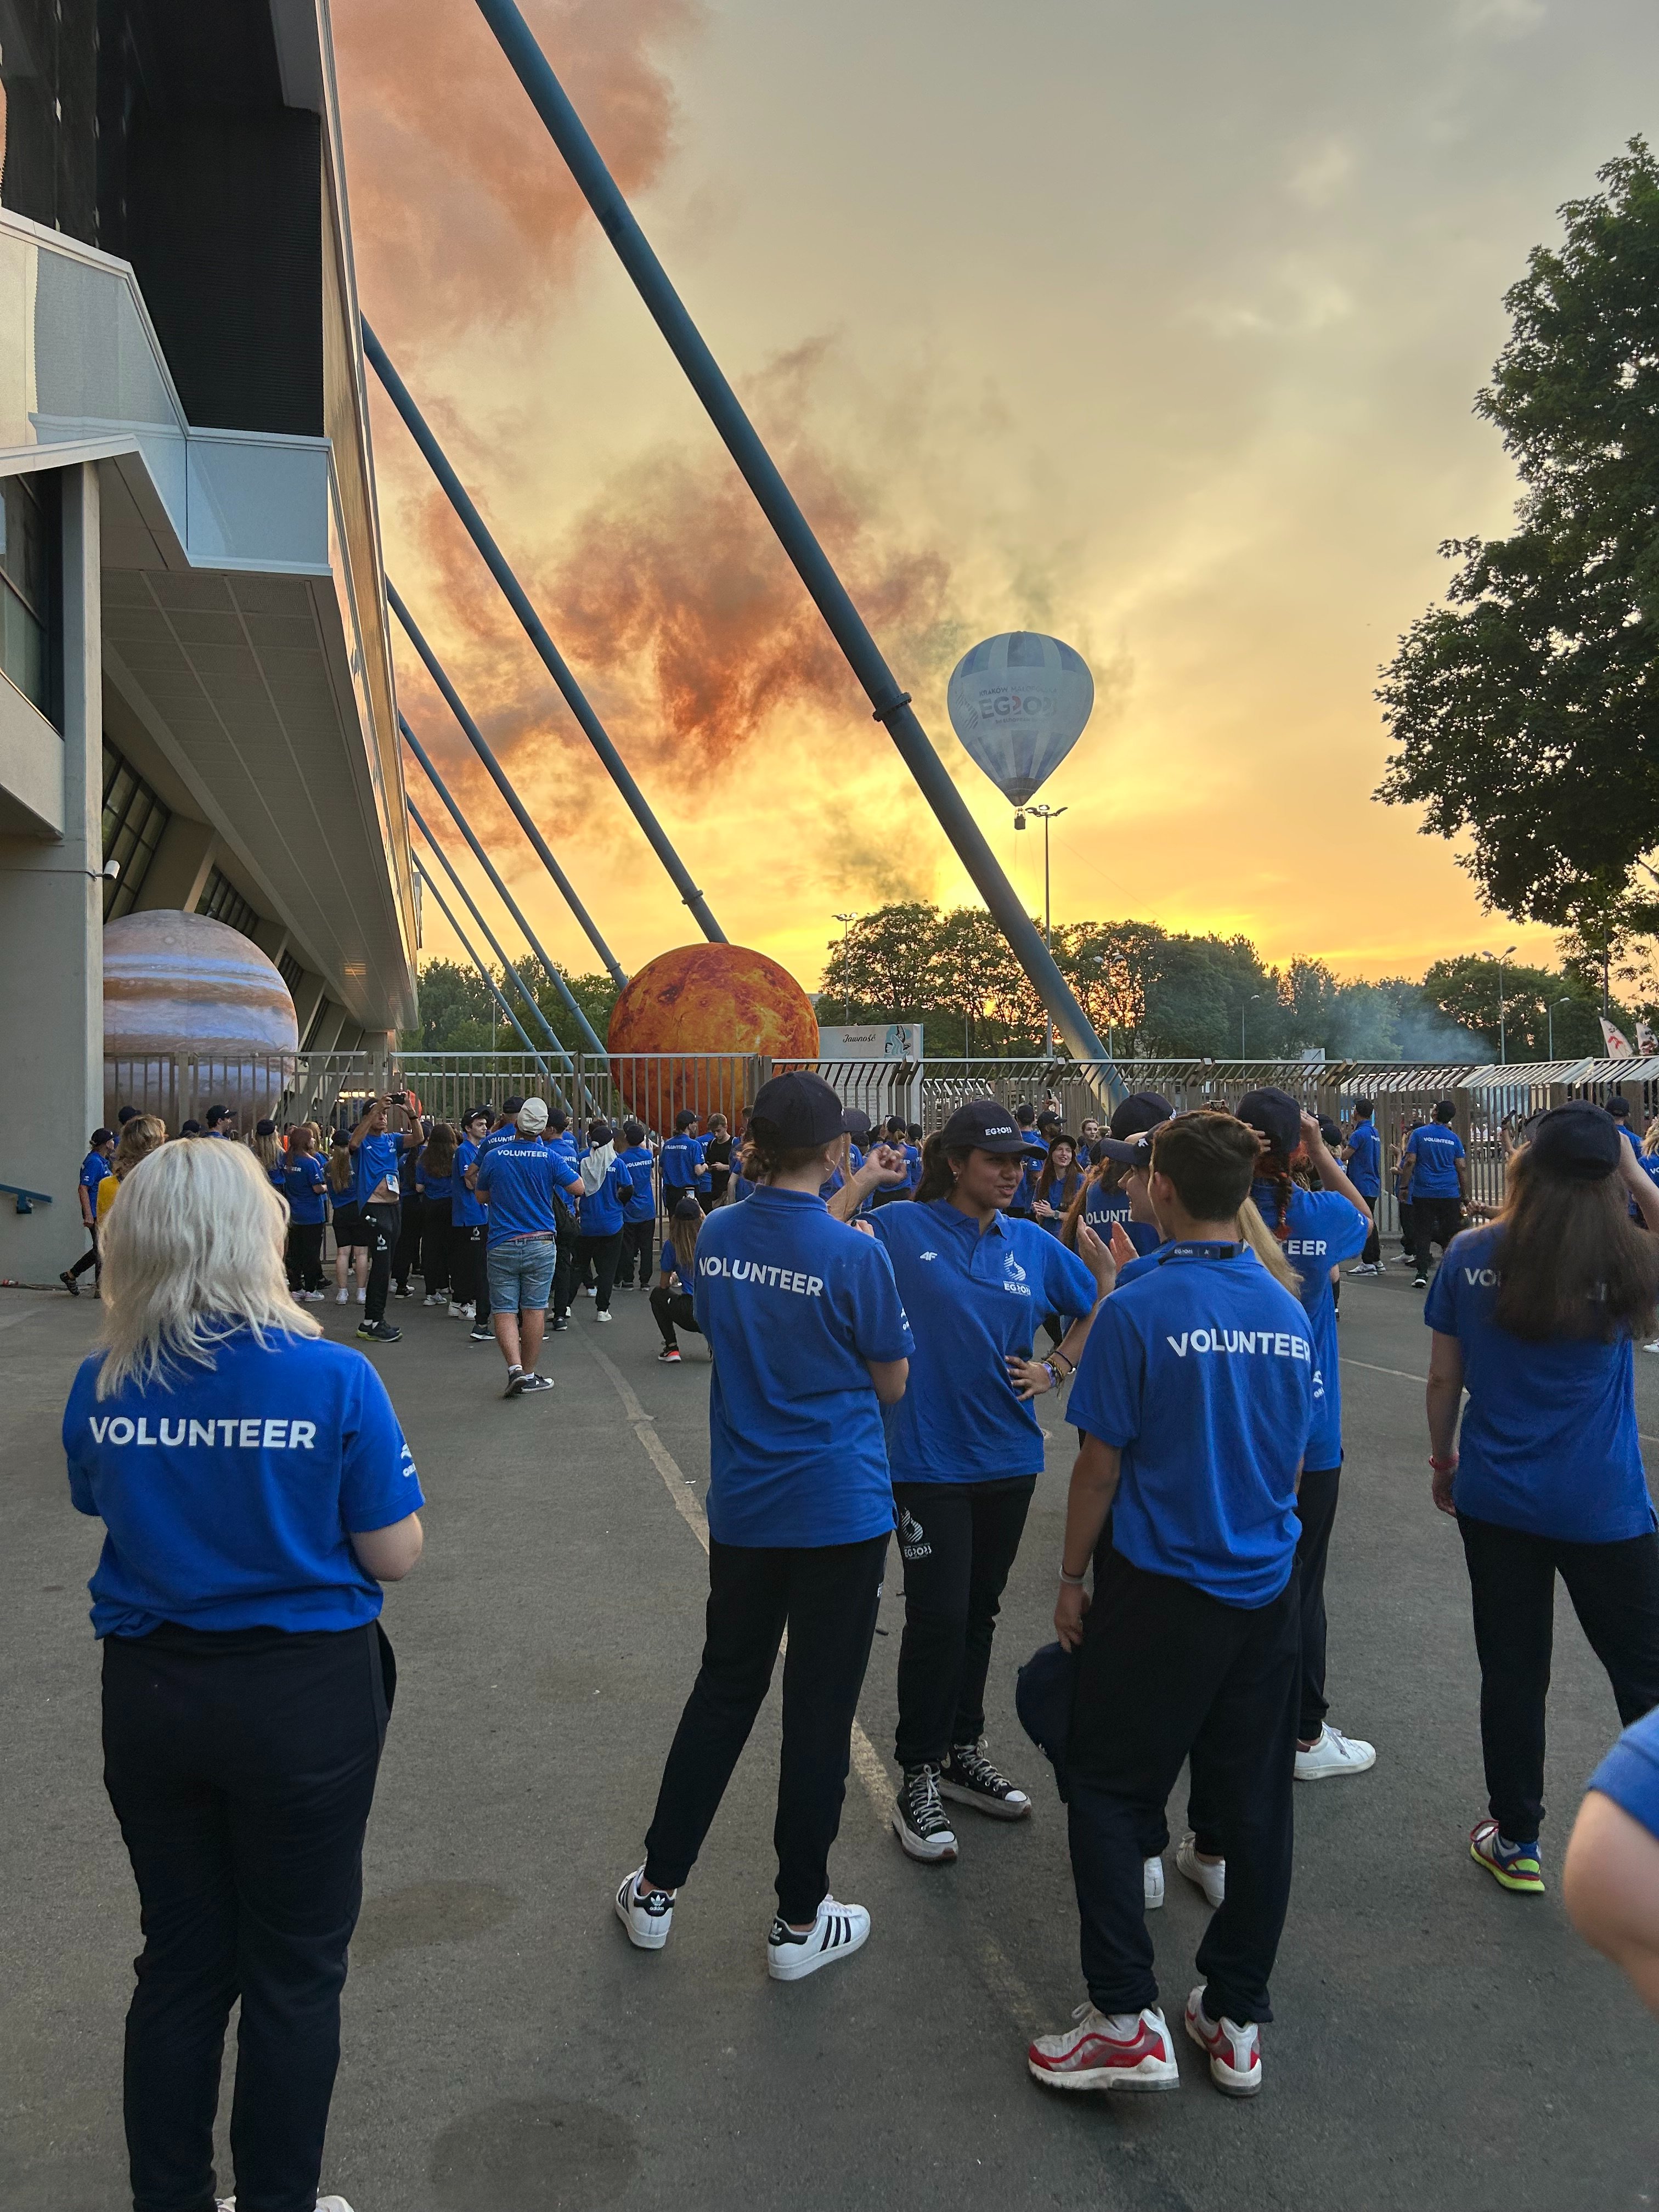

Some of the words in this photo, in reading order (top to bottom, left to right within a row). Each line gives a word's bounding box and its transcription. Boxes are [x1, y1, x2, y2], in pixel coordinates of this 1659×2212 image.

[843, 1034, 876, 1043] Jawność
[1424, 1137, 1454, 1146] VOLUNTEER
[497, 1149, 548, 1158] VOLUNTEER
[699, 1256, 823, 1296] VOLUNTEER
[89, 1417, 317, 1448] VOLUNTEER
